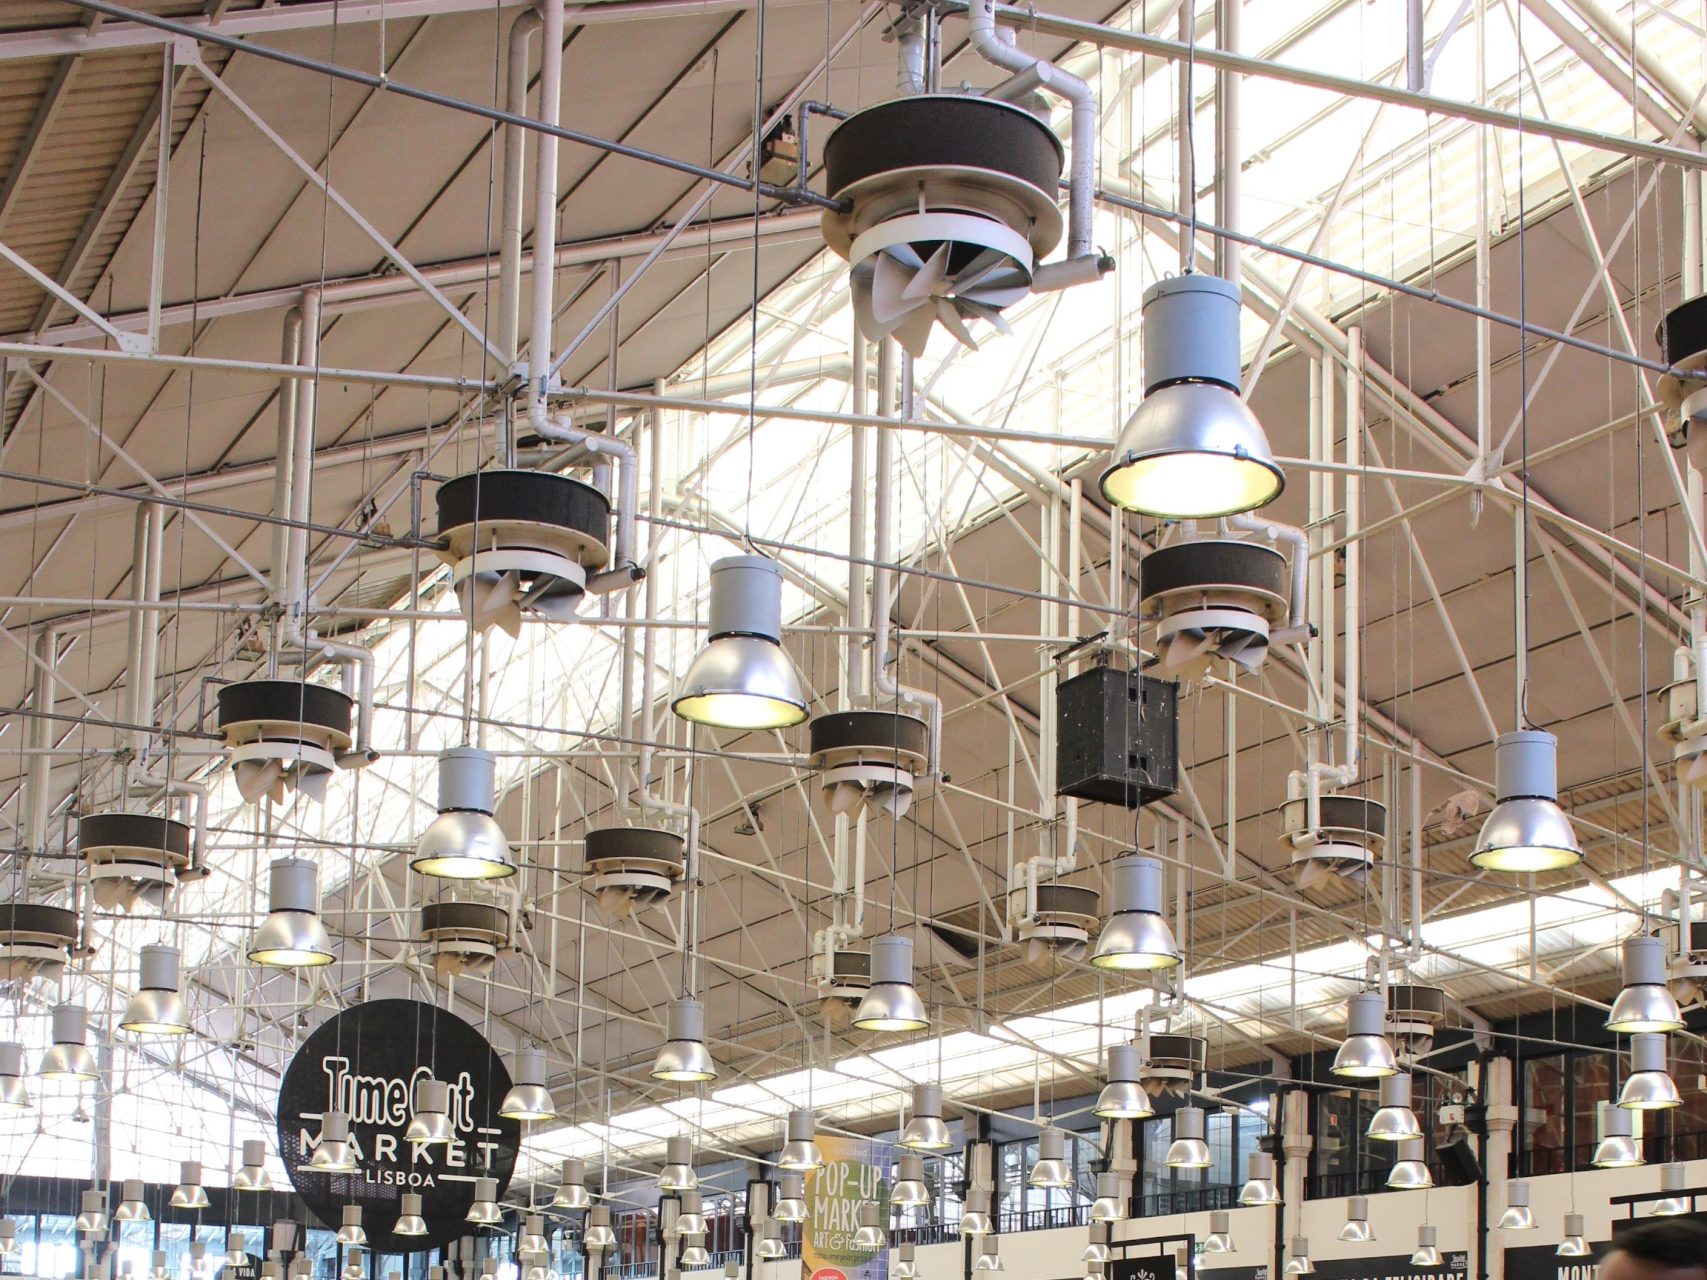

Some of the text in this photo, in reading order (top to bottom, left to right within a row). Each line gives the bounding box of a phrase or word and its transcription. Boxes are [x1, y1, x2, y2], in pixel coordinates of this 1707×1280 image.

[323, 1056, 408, 1126] Time
[366, 1170, 435, 1187] LISBOA
[815, 1162, 882, 1200] POP-UP
[813, 1196, 881, 1233] MARK
[813, 1231, 830, 1249] ART
